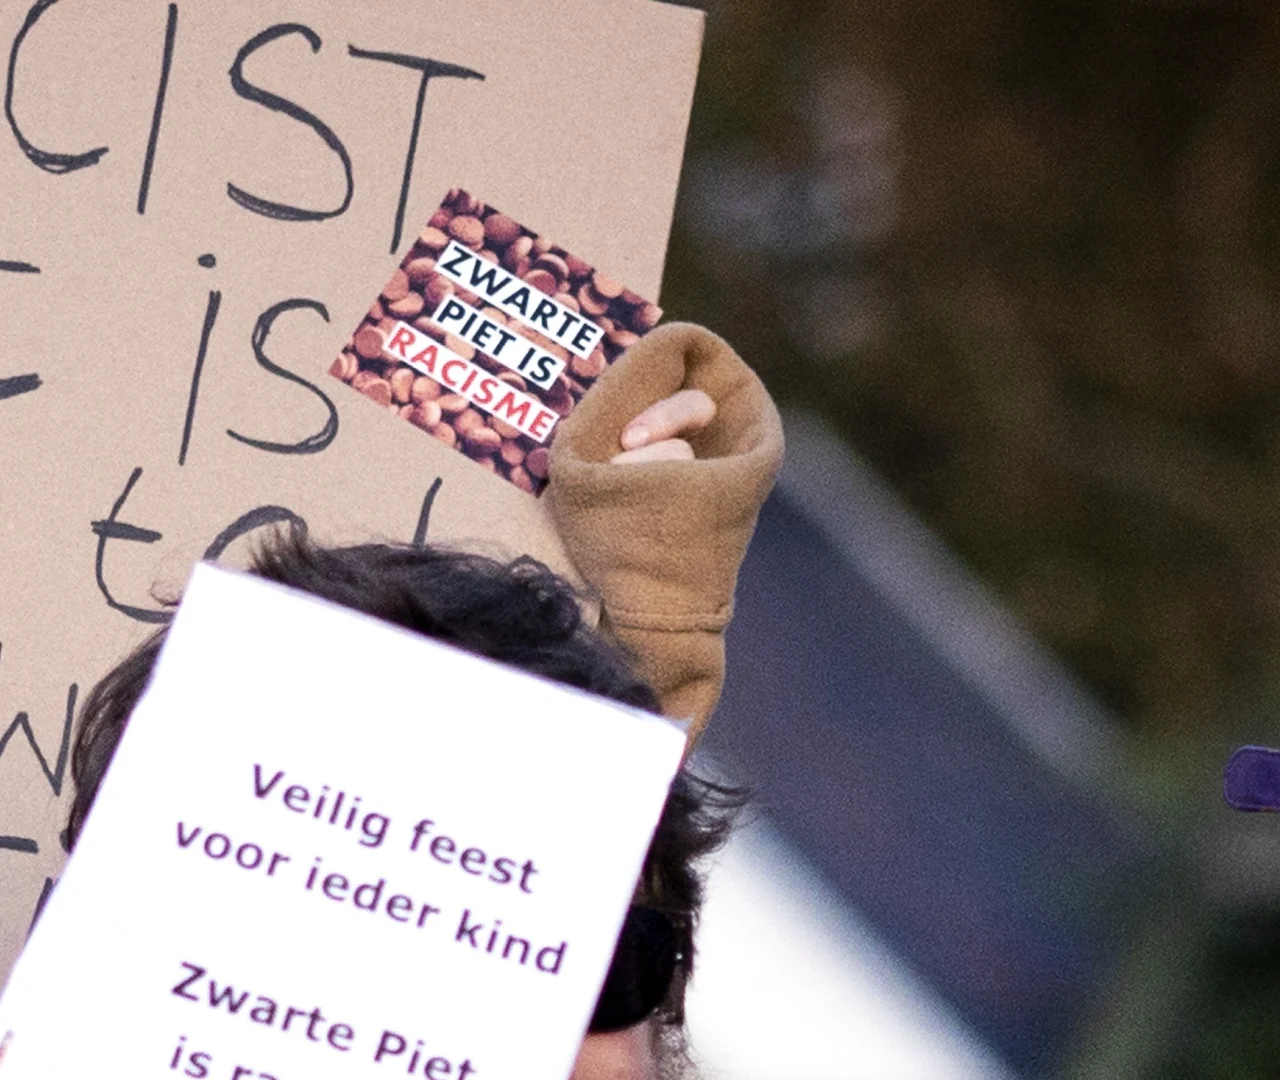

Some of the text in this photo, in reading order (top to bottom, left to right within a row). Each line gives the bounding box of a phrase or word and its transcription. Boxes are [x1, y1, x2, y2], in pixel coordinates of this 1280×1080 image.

[437, 299, 558, 384] PIET IS
[441, 245, 598, 352] ZWARTE
[179, 252, 339, 466] is
[387, 326, 554, 439] RACISME
[251, 763, 541, 895] Veilig feest
[174, 819, 569, 977] voor ieder kind
[169, 1036, 210, 1079] is
[171, 962, 357, 1052] Zwarte
